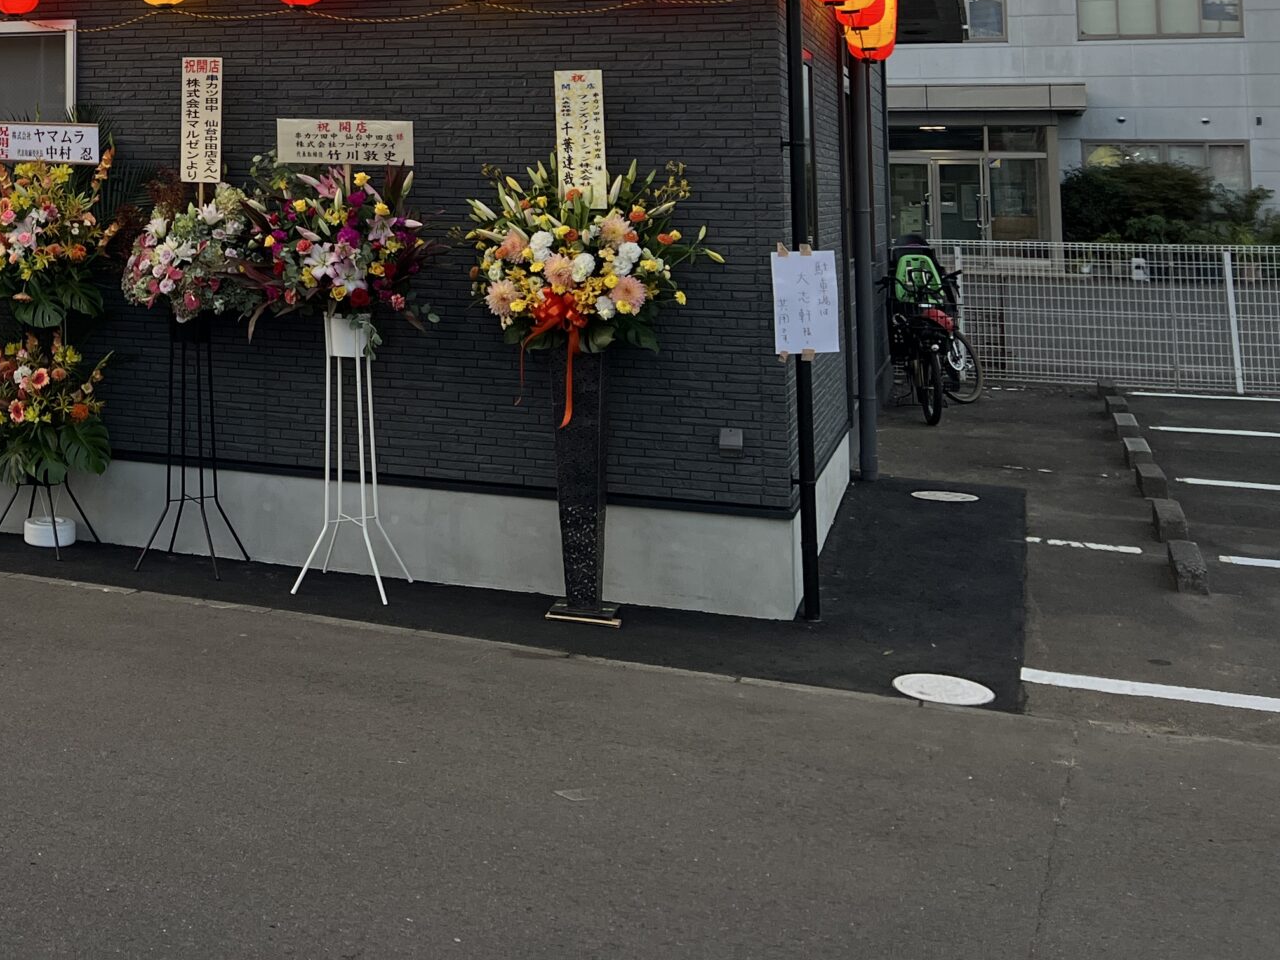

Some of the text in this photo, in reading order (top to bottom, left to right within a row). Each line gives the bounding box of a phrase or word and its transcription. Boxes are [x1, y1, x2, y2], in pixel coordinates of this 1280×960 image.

[184, 59, 220, 74] 祝開店
[569, 73, 586, 83] 祝
[186, 77, 201, 181] 株式会社マルゼンより
[204, 74, 219, 180] 串カツ田中 仙台中田店さんへ
[34, 128, 85, 144] ヤマムラ
[295, 132, 338, 141] 串カツ田中
[46, 145, 72, 160] 中村
[80, 147, 93, 161] 忍
[328, 149, 399, 162] 竹川敦史
[561, 121, 576, 188] 千葉達哉
[815, 261, 831, 317] 駐車場は
